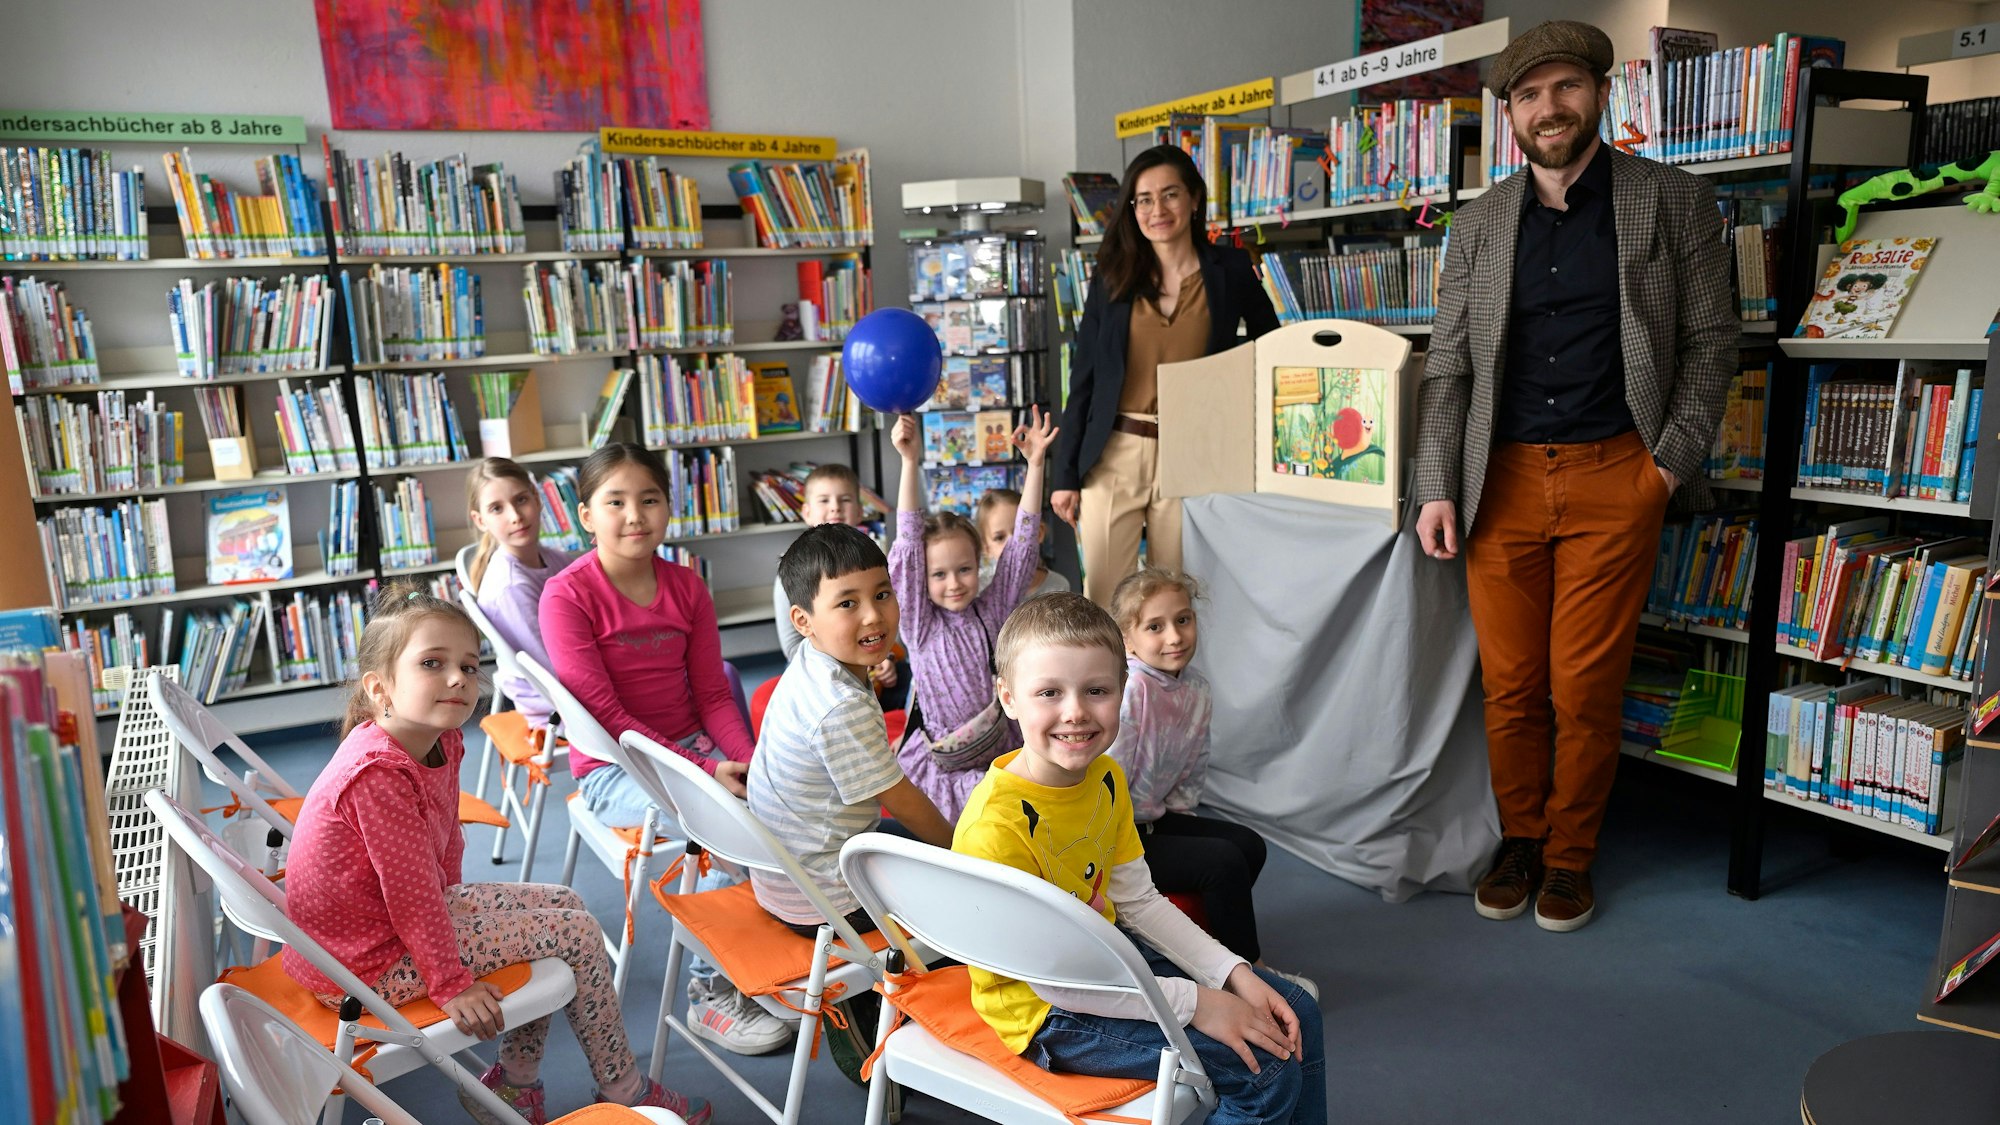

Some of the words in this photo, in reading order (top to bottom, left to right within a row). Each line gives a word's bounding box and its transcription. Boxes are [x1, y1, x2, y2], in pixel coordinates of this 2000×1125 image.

[1960, 28, 1986, 47] 5.1
[1318, 68, 1335, 86] 4.1
[1341, 65, 1357, 82] ab
[1361, 61, 1368, 77] 6
[1396, 47, 1437, 69] Jahre
[1212, 96, 1225, 111] ab
[1229, 93, 1235, 106] 4
[1240, 87, 1274, 105] Jahre
[0, 115, 173, 134] ndersachbücher
[181, 119, 205, 135] ab
[211, 120, 222, 135] 8
[229, 120, 282, 136] Jahre
[607, 132, 743, 152] Kindersachbücher
[749, 137, 766, 152] ab
[770, 140, 778, 151] 4
[782, 141, 821, 154] Jahre
[1949, 584, 1960, 606] Michel
[1940, 612, 1950, 637] Lindgren
